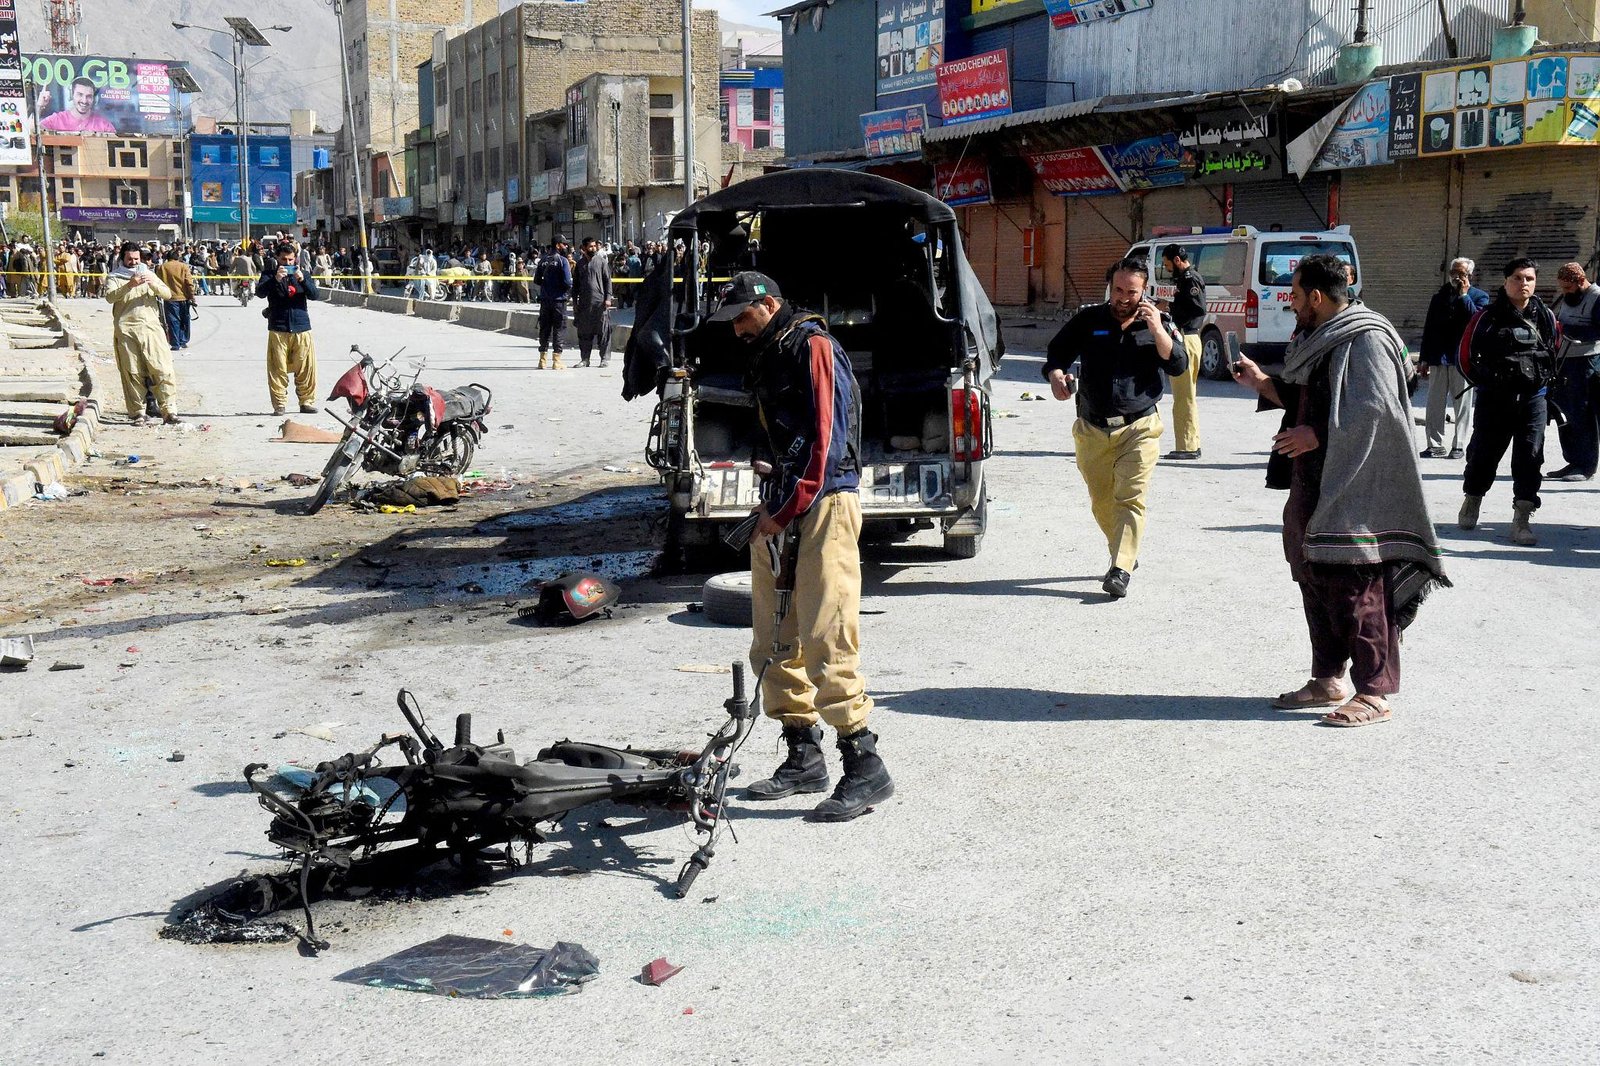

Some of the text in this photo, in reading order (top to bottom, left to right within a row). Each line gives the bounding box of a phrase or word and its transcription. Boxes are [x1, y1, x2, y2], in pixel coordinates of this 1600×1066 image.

[949, 62, 967, 74] FOOD
[967, 54, 1002, 70] CHEMICAL
[82, 60, 131, 89] GB
[142, 76, 165, 84] PLUS
[1394, 114, 1415, 131] A.R
[1393, 132, 1414, 141] Traders
[1156, 286, 1175, 298] AMBULA
